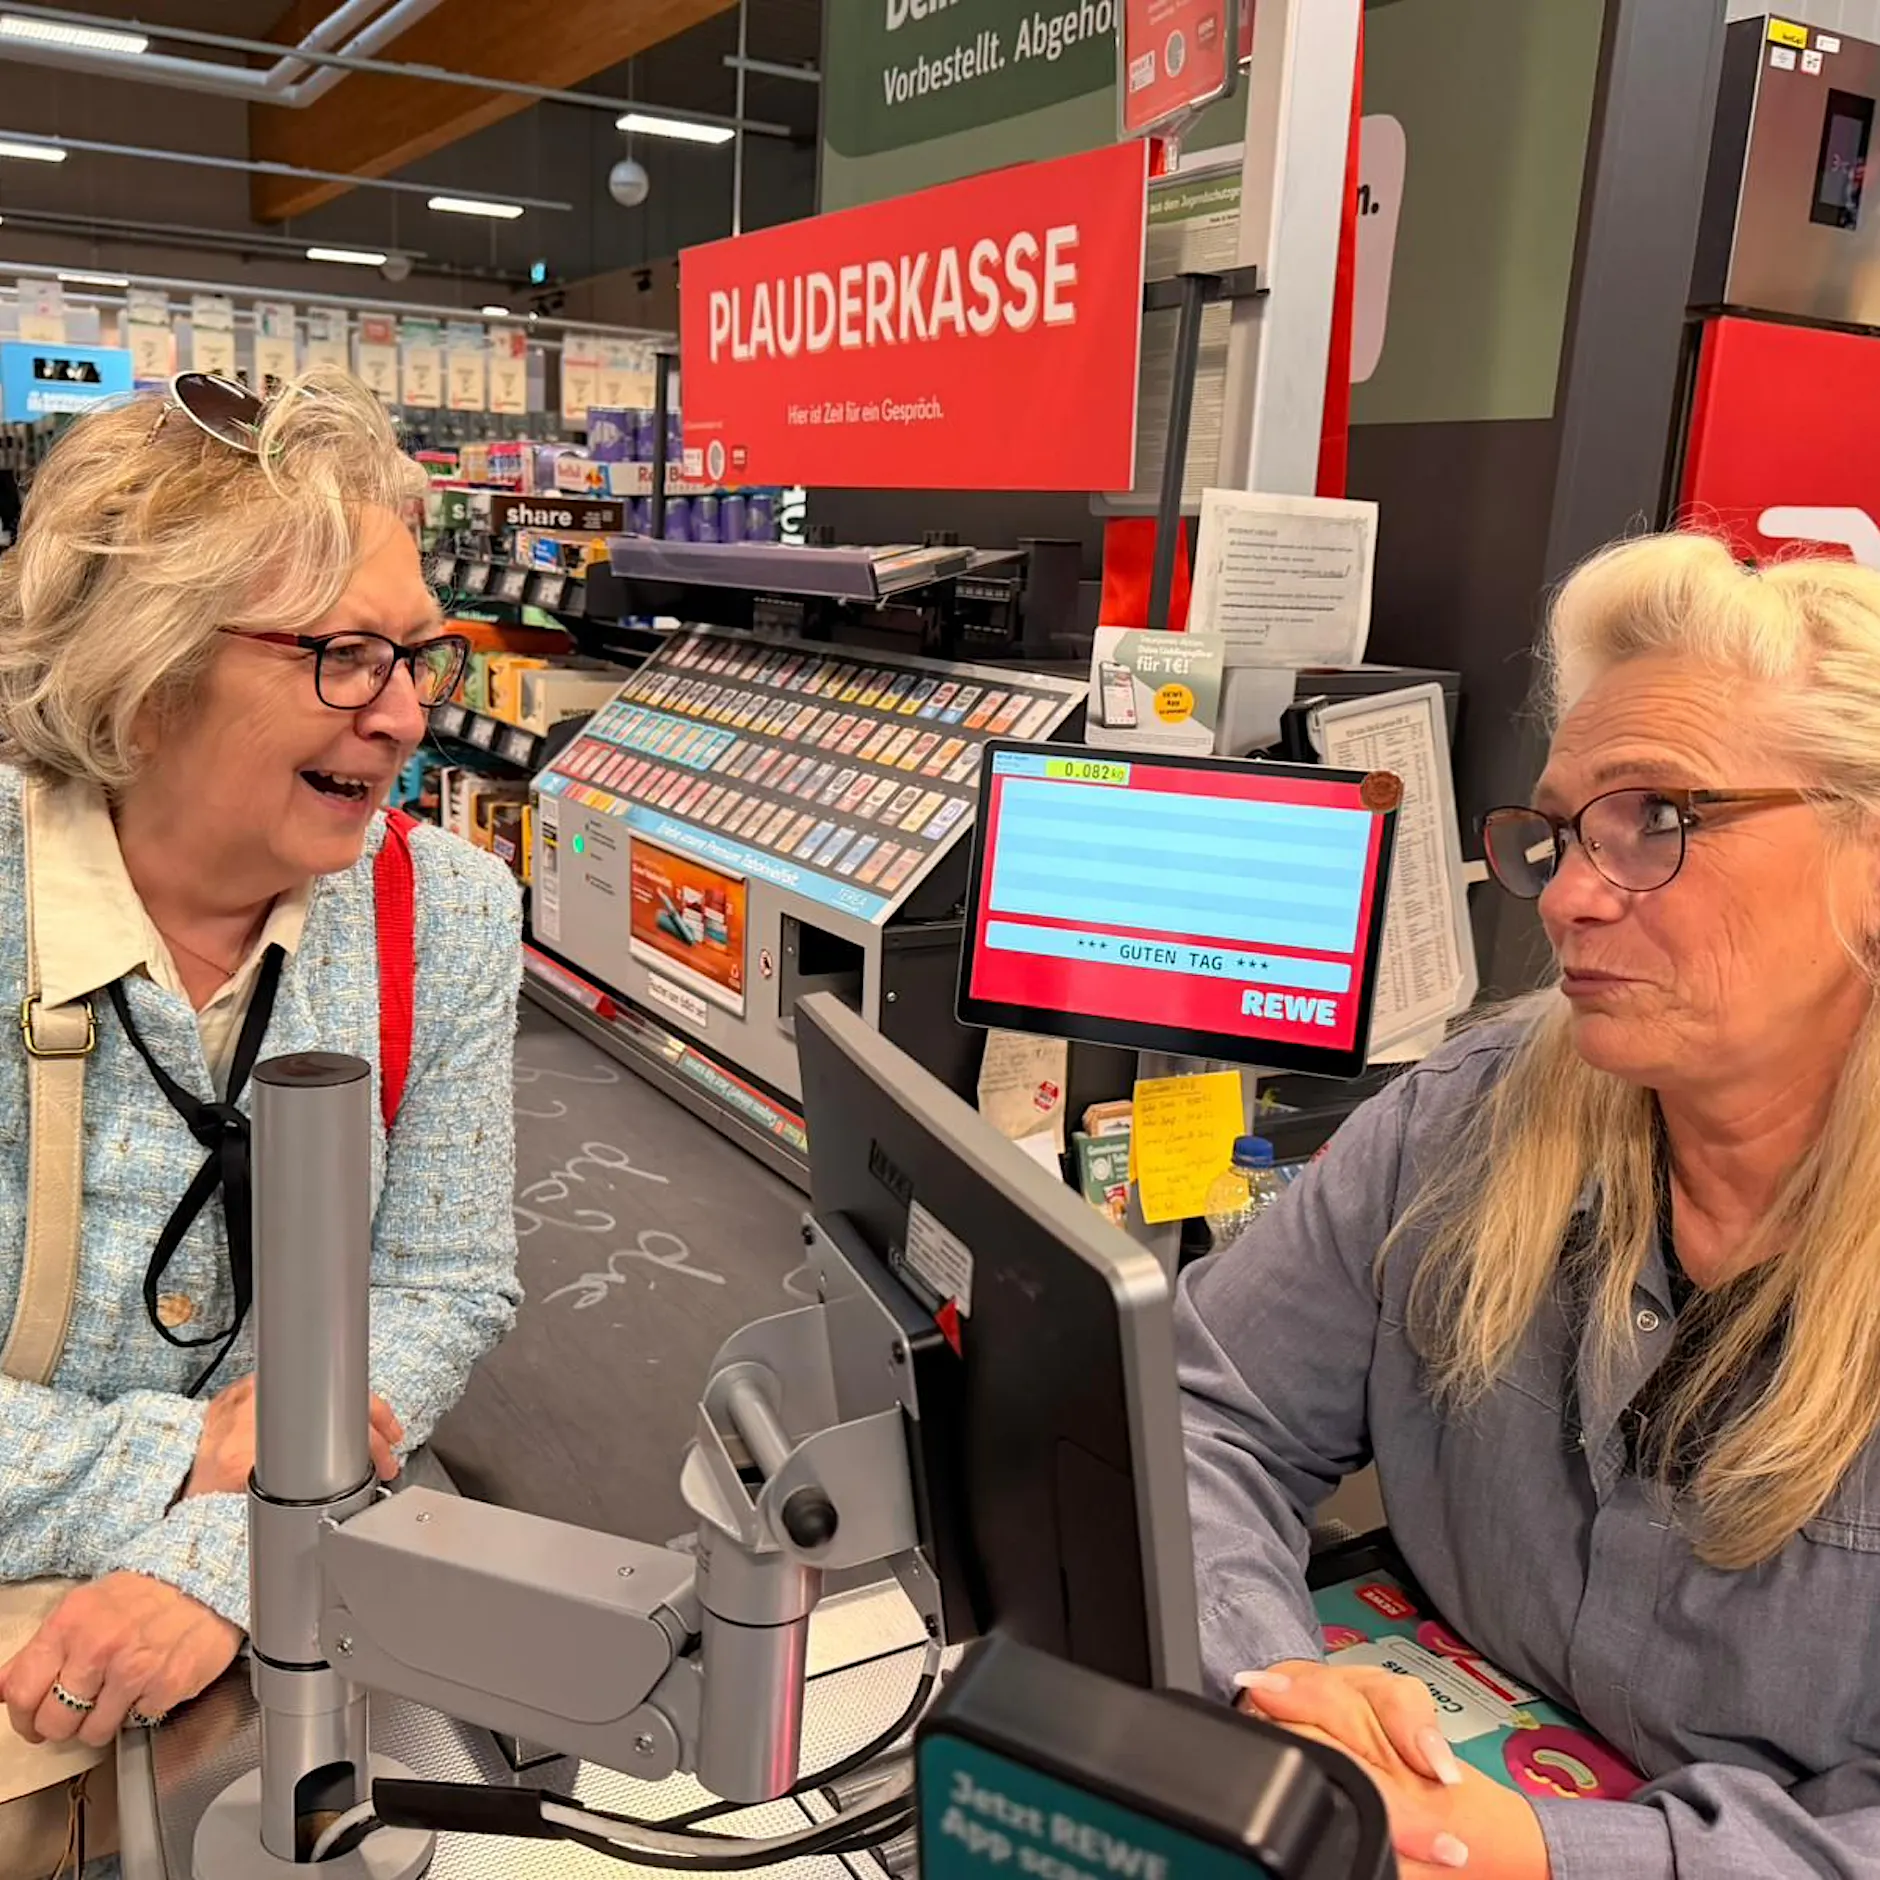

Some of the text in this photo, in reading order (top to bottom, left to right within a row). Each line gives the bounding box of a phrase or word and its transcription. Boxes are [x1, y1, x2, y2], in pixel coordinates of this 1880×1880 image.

[883, 37, 1005, 106] Vorbestellt.
[709, 224, 1079, 364] PLAUDERKASSE
[787, 394, 944, 426] Hier ist Zeit für ein Gespräch.
[506, 503, 573, 528] share
[1065, 762, 1110, 779] 0.082
[1119, 944, 1224, 971] GUTEN TAG
[1241, 989, 1338, 1028] REWE
[940, 1806, 1013, 1863] App
[950, 1769, 1170, 1880] Jetzt REWE
